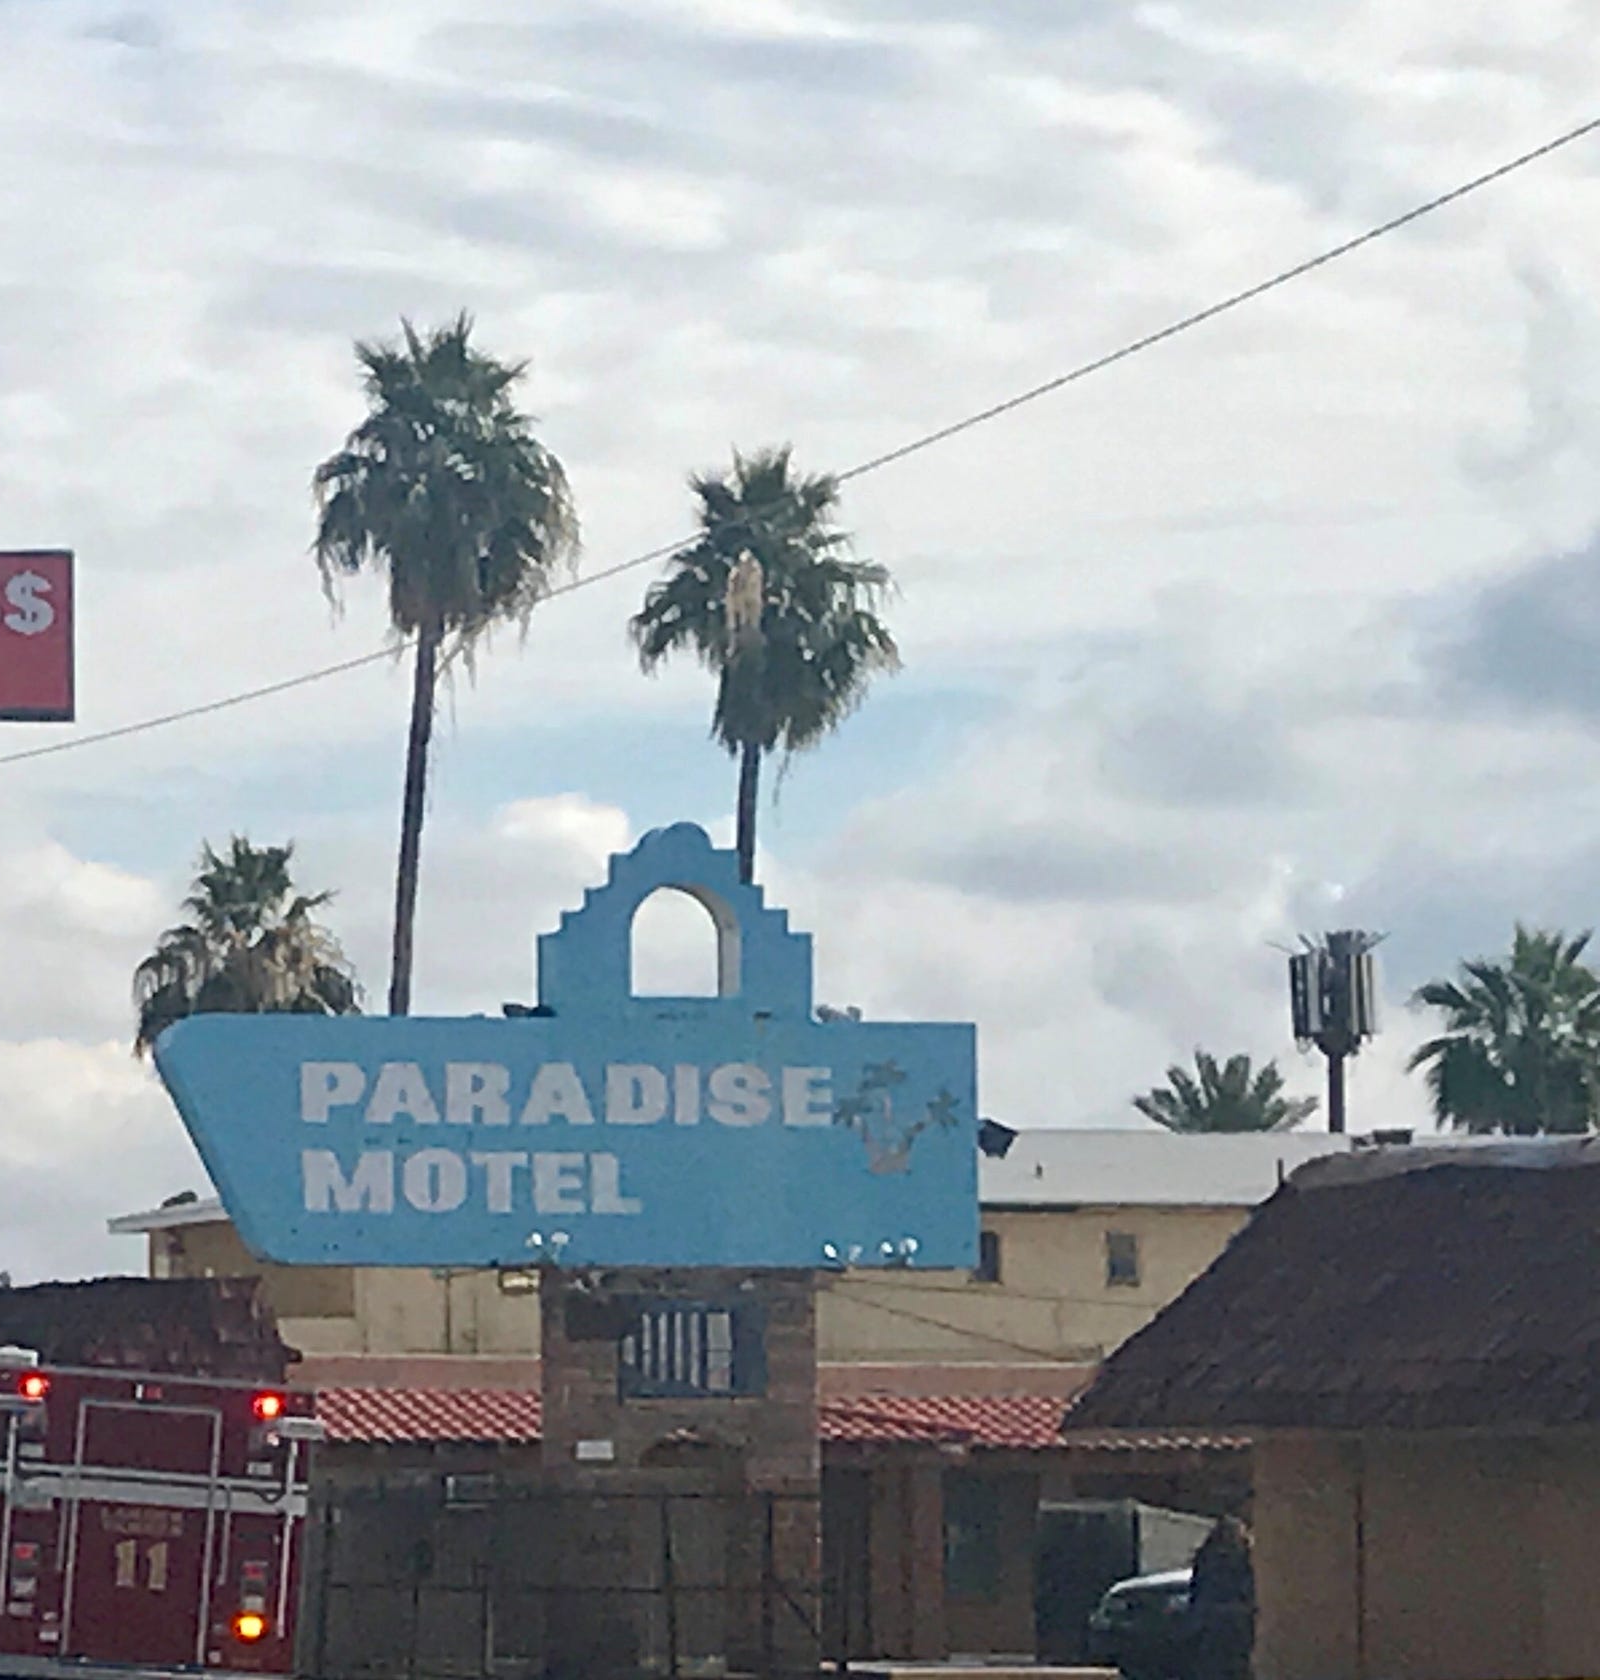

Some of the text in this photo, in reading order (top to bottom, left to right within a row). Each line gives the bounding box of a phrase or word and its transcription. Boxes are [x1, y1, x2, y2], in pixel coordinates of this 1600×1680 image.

[300, 1061, 834, 1127] PARADISE
[301, 1149, 643, 1216] MOTEL
[114, 1539, 168, 1591] 11
